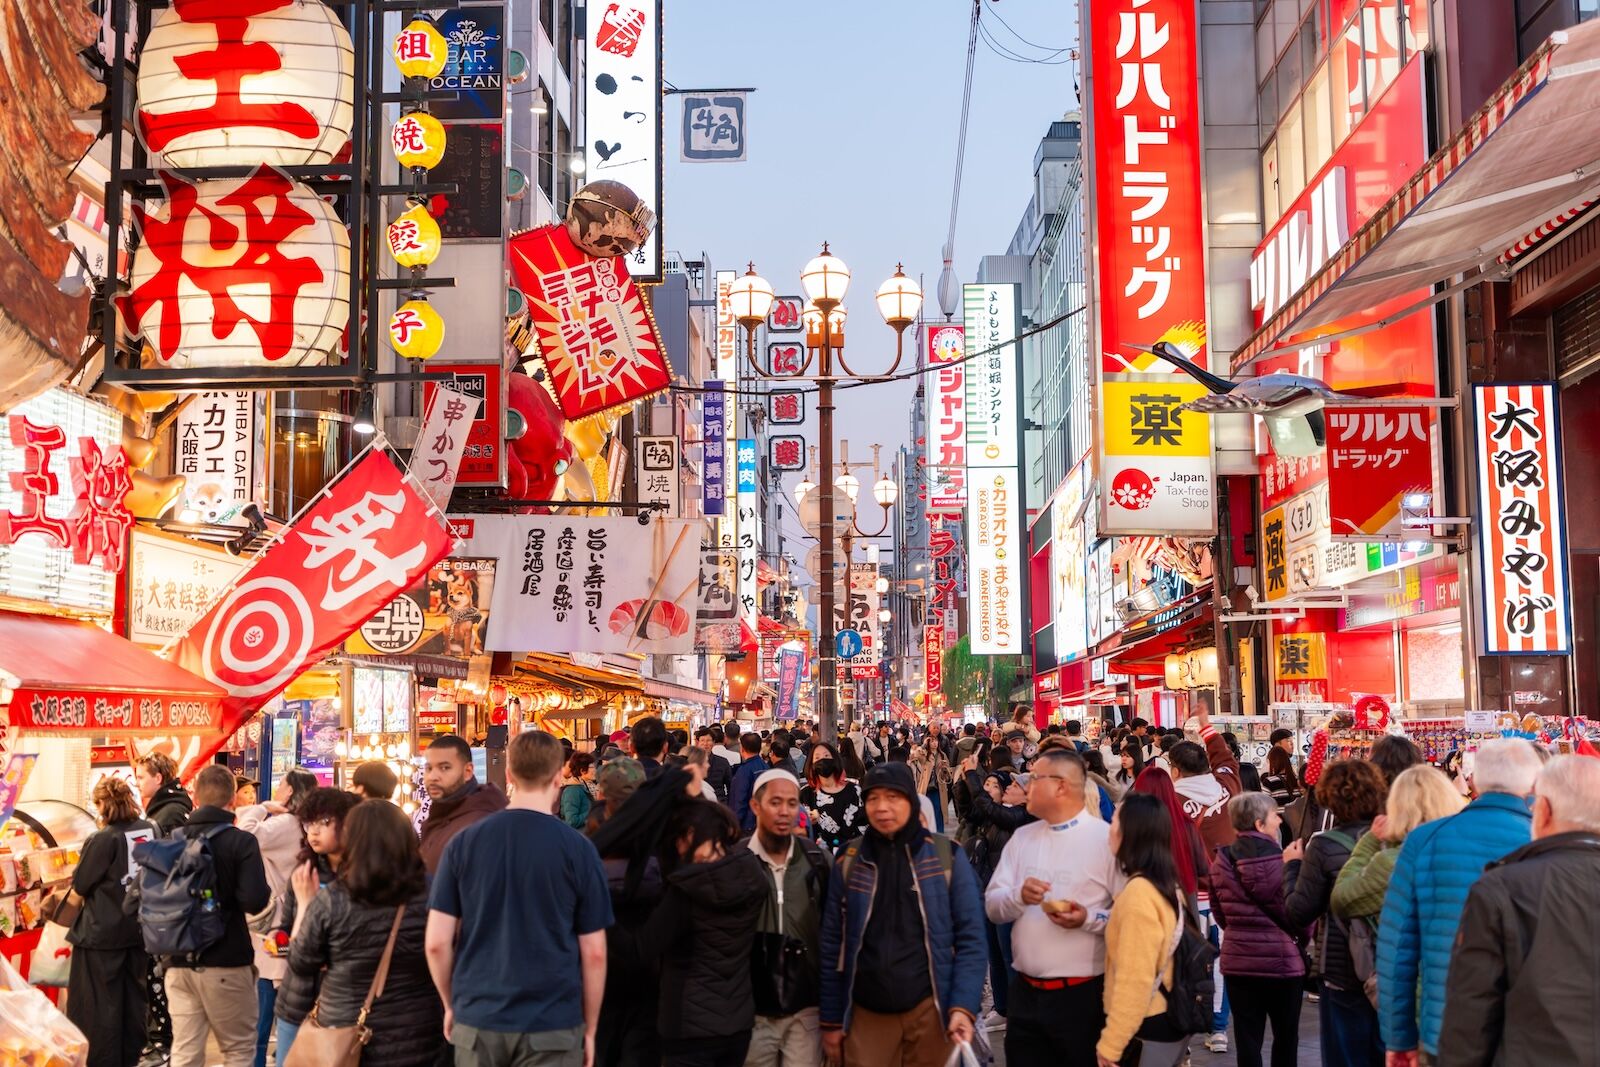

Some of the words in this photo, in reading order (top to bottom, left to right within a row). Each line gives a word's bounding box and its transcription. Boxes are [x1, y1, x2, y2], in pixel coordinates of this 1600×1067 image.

[447, 49, 486, 63] BAR
[431, 75, 500, 88] OCEAN
[692, 109, 737, 144] 牛角
[1115, 0, 1181, 320] ルハドラッグ
[542, 272, 606, 394] ミュージアム
[418, 398, 467, 481] 串かつ
[940, 366, 964, 495] ジャンカラ
[1130, 394, 1183, 446] 薬
[1330, 413, 1427, 442] ツルハ
[182, 421, 199, 473] 大阪店
[738, 447, 755, 485] 焼肉
[1332, 448, 1409, 469] ドラッグ
[234, 450, 247, 499] CAFE
[1165, 485, 1209, 496] Tax-free
[1169, 472, 1208, 483] Japan.
[978, 490, 988, 545] KARAOKE
[993, 488, 1008, 547] カラオケ
[1182, 497, 1209, 509] Shop
[1290, 500, 1313, 533] くすり
[1492, 401, 1554, 635] 大阪みやげ
[454, 561, 492, 571] OSAKA
[520, 528, 546, 597] 居酒屋
[1265, 519, 1287, 592] 薬
[980, 569, 990, 642] MANEKINEKO
[994, 564, 1010, 648] まねきねこ
[852, 657, 872, 665] BAR
[1279, 637, 1310, 676] 薬
[31, 694, 87, 725] 大阪王将
[140, 698, 163, 726] 餃子
